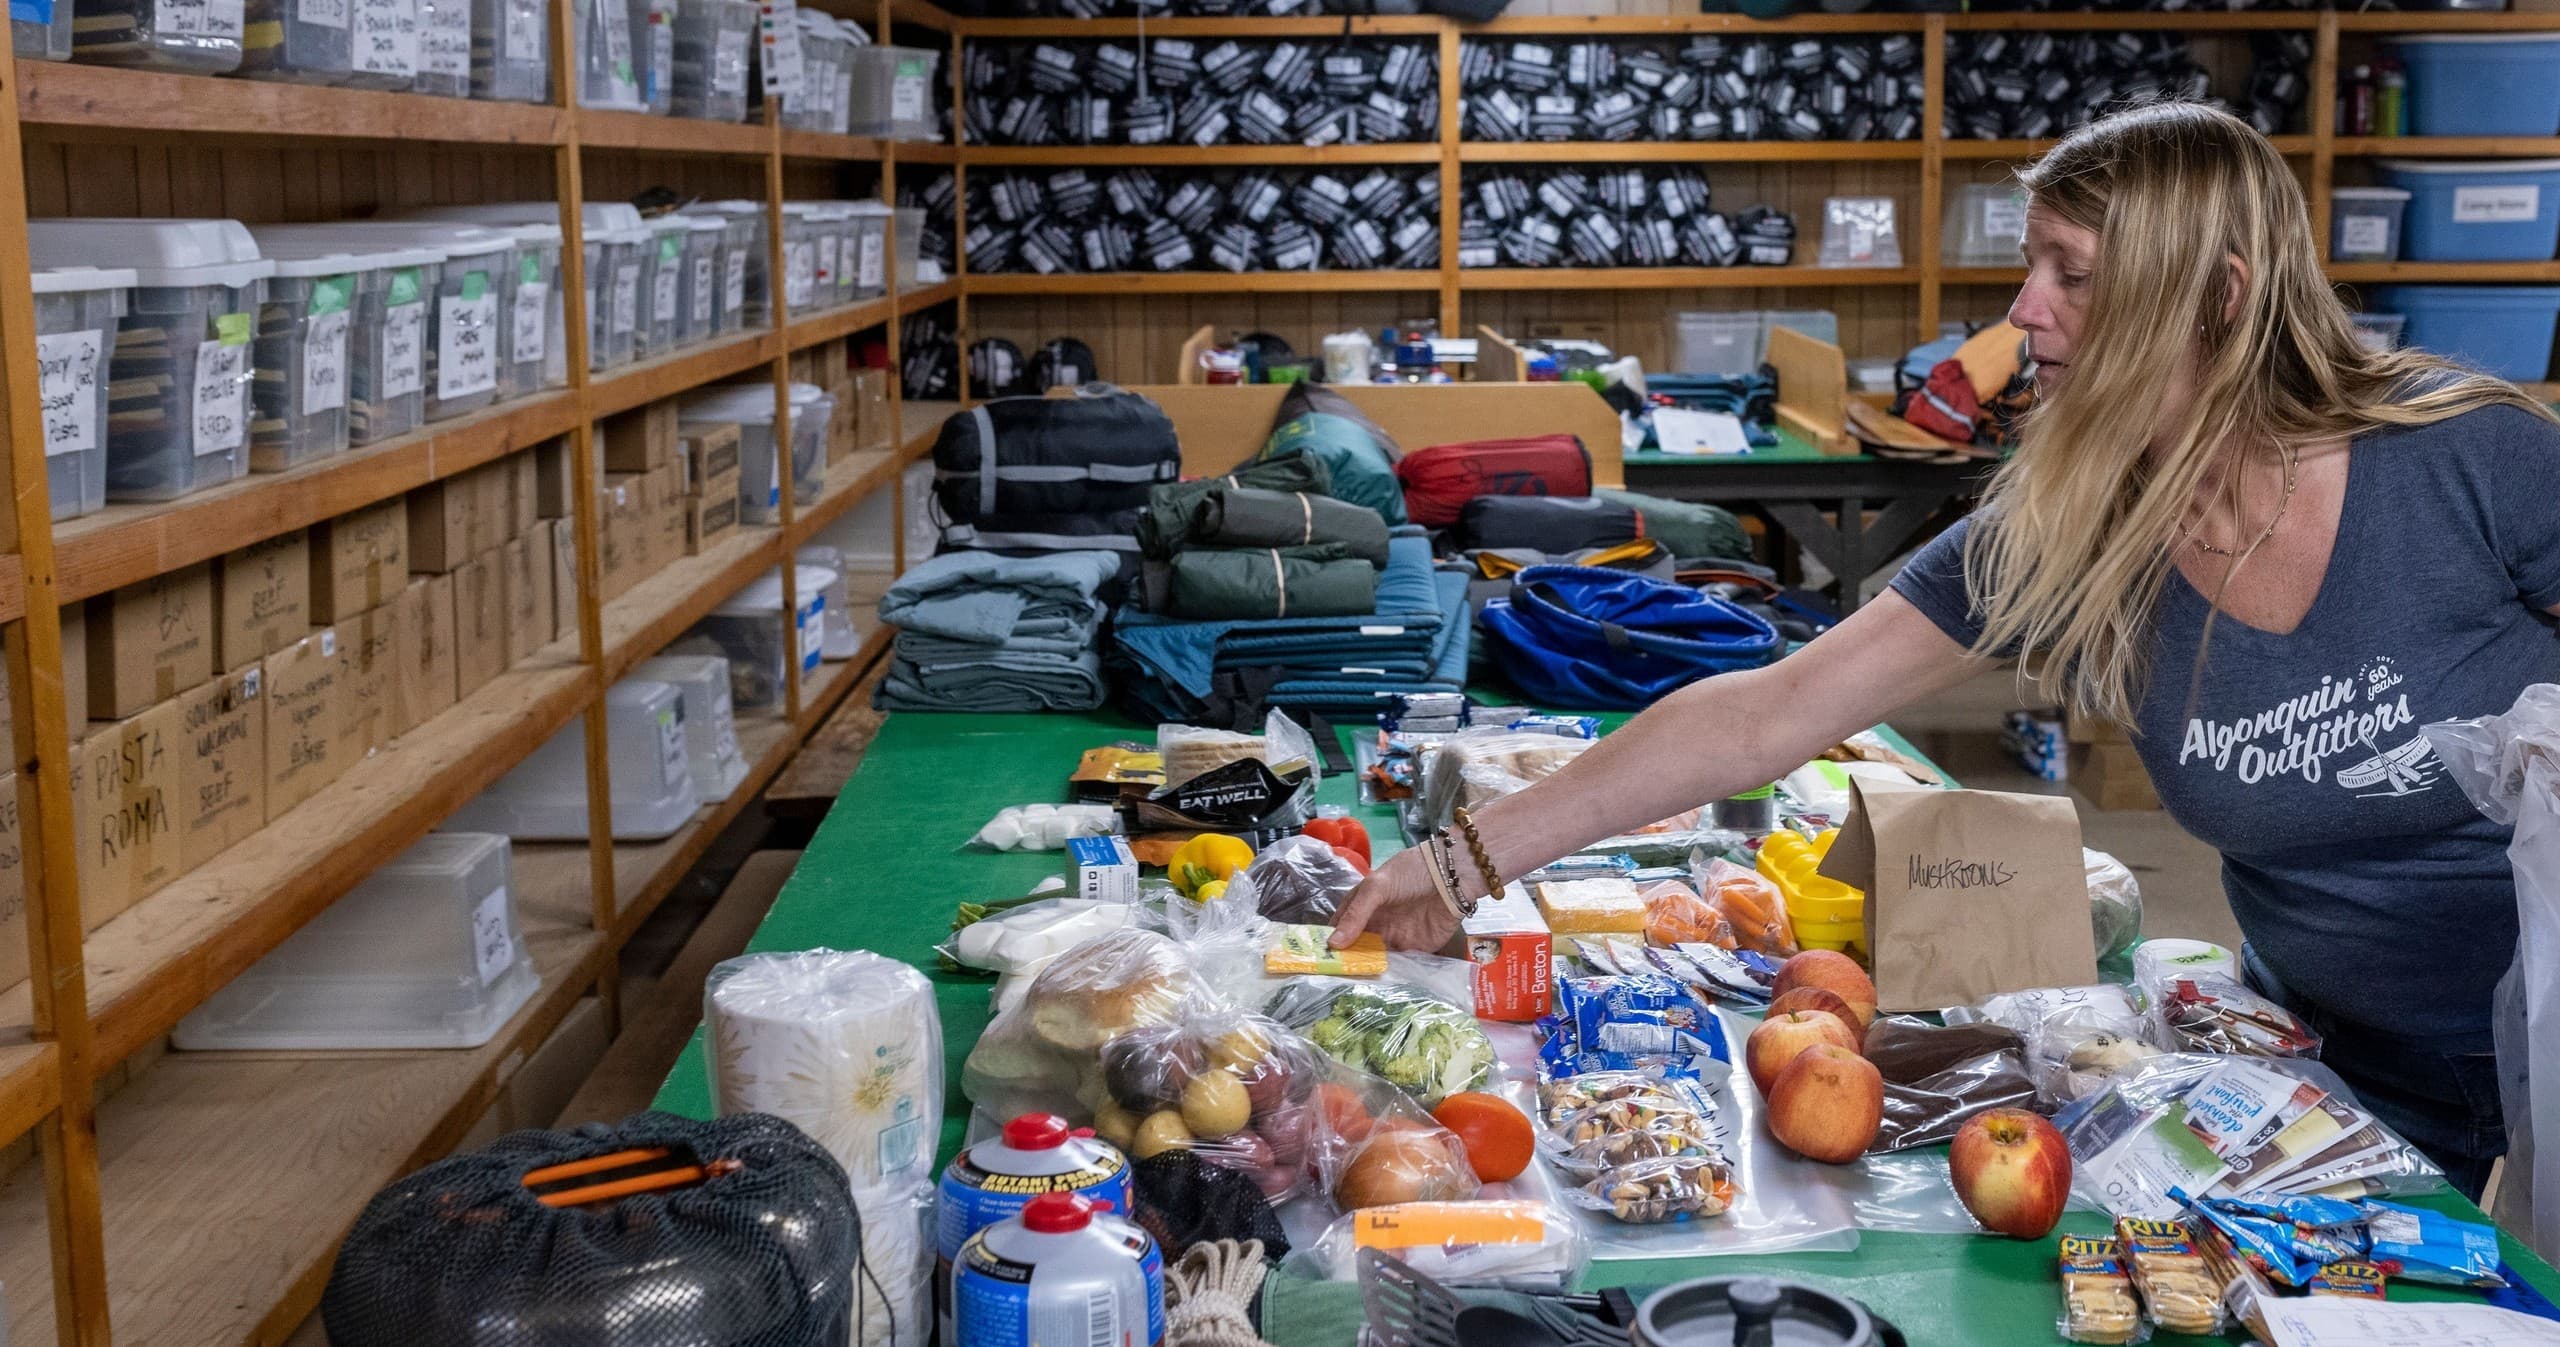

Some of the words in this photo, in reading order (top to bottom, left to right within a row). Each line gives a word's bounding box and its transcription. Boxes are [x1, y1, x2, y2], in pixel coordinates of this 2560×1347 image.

[2367, 673, 2403, 701] years
[2368, 664, 2388, 683] 60
[2179, 675, 2357, 772] Algonquin
[2238, 694, 2416, 785] Outfitters
[96, 728, 165, 801] PASTA
[1179, 796, 1214, 810] EAT
[1215, 788, 1266, 806] WELL
[101, 788, 170, 869] ROMA
[1531, 942, 1547, 994] Breton
[2191, 1097, 2244, 1133] cleansed
[983, 1172, 1049, 1188] BUTANE
[2120, 1216, 2181, 1237] RITZ
[2061, 1236, 2115, 1257] RITZ
[2319, 1262, 2380, 1279] RITZ
